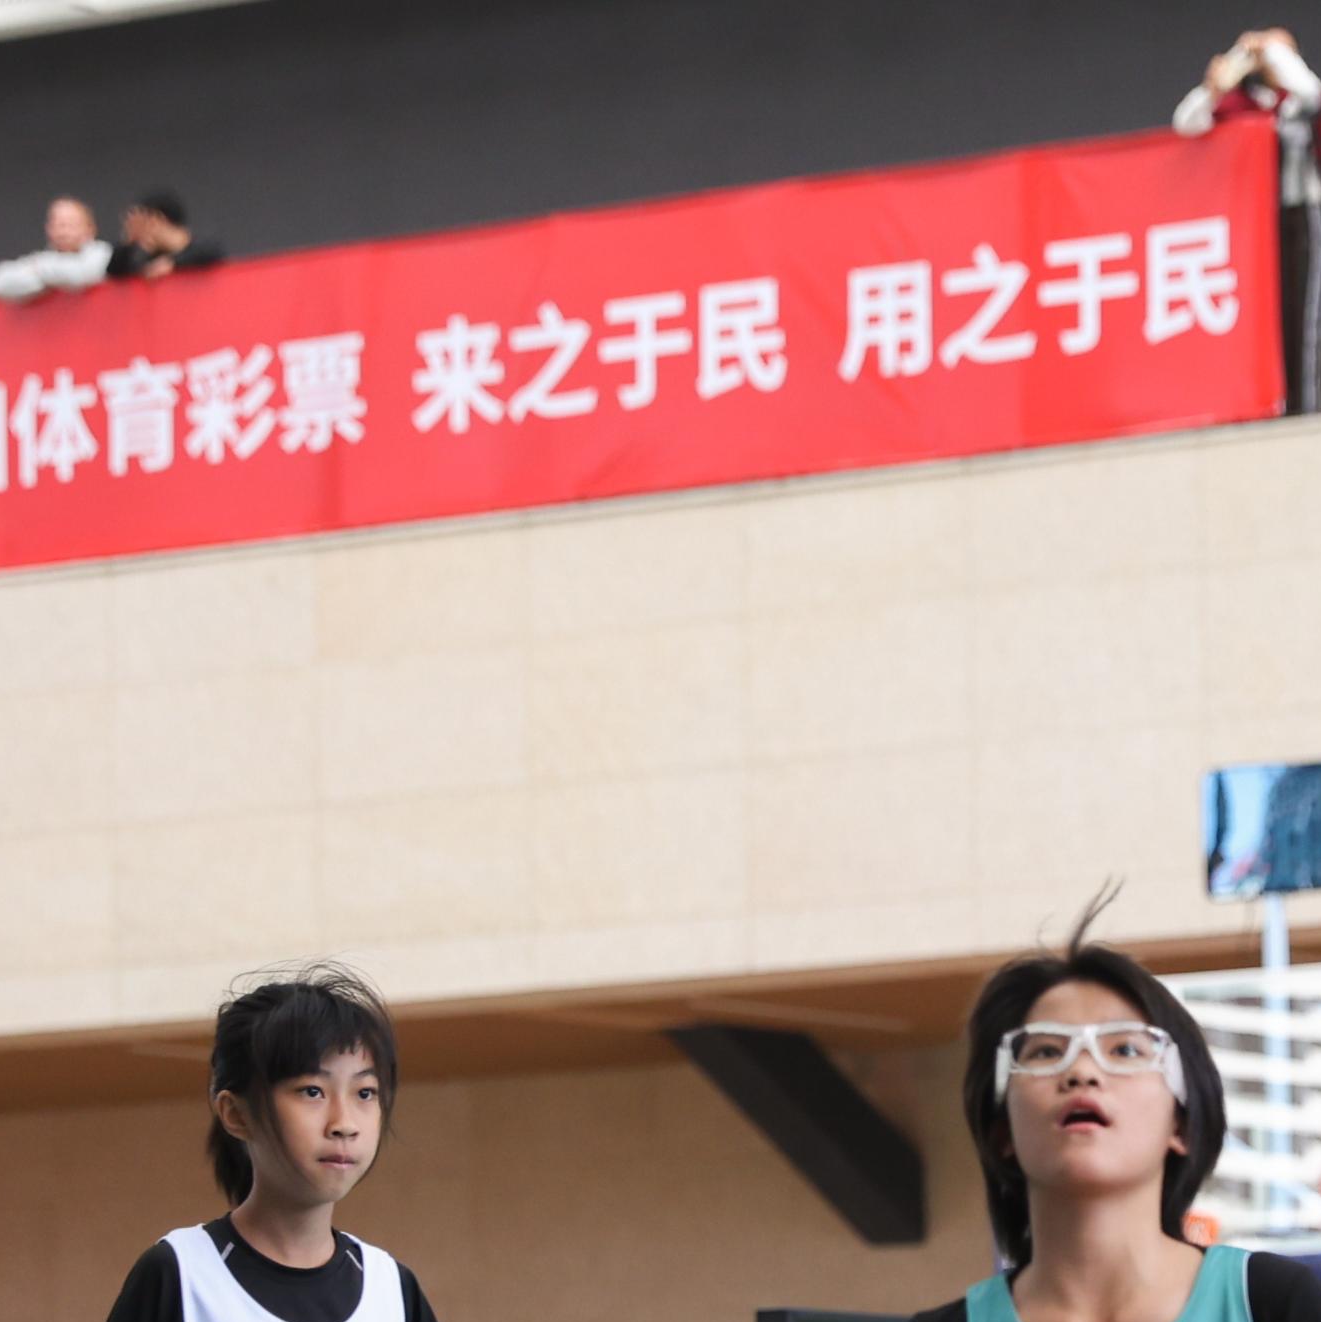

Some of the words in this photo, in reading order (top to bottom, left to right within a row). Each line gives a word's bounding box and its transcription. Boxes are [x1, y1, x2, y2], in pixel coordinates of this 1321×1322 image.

[412, 277, 787, 434] 来之于民
[839, 216, 1240, 384] 用之于民
